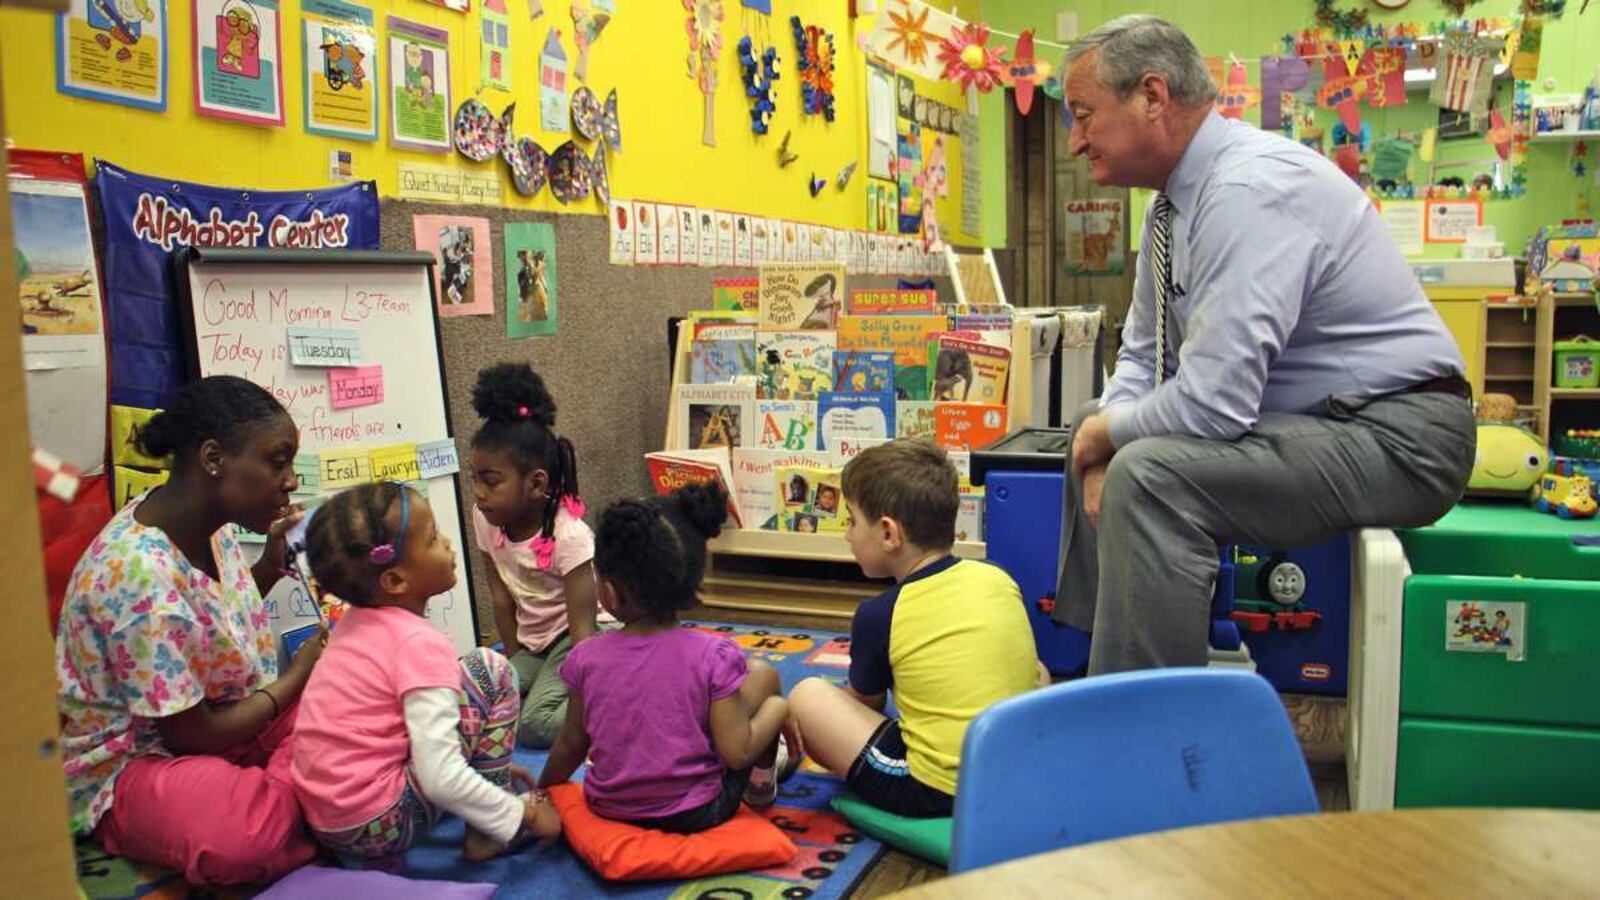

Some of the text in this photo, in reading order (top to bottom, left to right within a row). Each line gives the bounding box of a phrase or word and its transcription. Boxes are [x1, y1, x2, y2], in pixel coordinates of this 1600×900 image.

[1067, 202, 1121, 213] CARING
[133, 193, 349, 251] Alphabet Center
[787, 273, 799, 285] Do
[203, 278, 258, 326] Good
[861, 320, 889, 336] Sally
[201, 333, 264, 371] Today
[294, 334, 352, 361] Tuesday
[334, 375, 379, 401] Monday
[680, 389, 751, 400] ALPHABET CITY
[310, 407, 361, 442] friends
[326, 458, 361, 481] Ersil
[371, 455, 420, 486] Lauryn
[420, 446, 456, 471] Aiden
